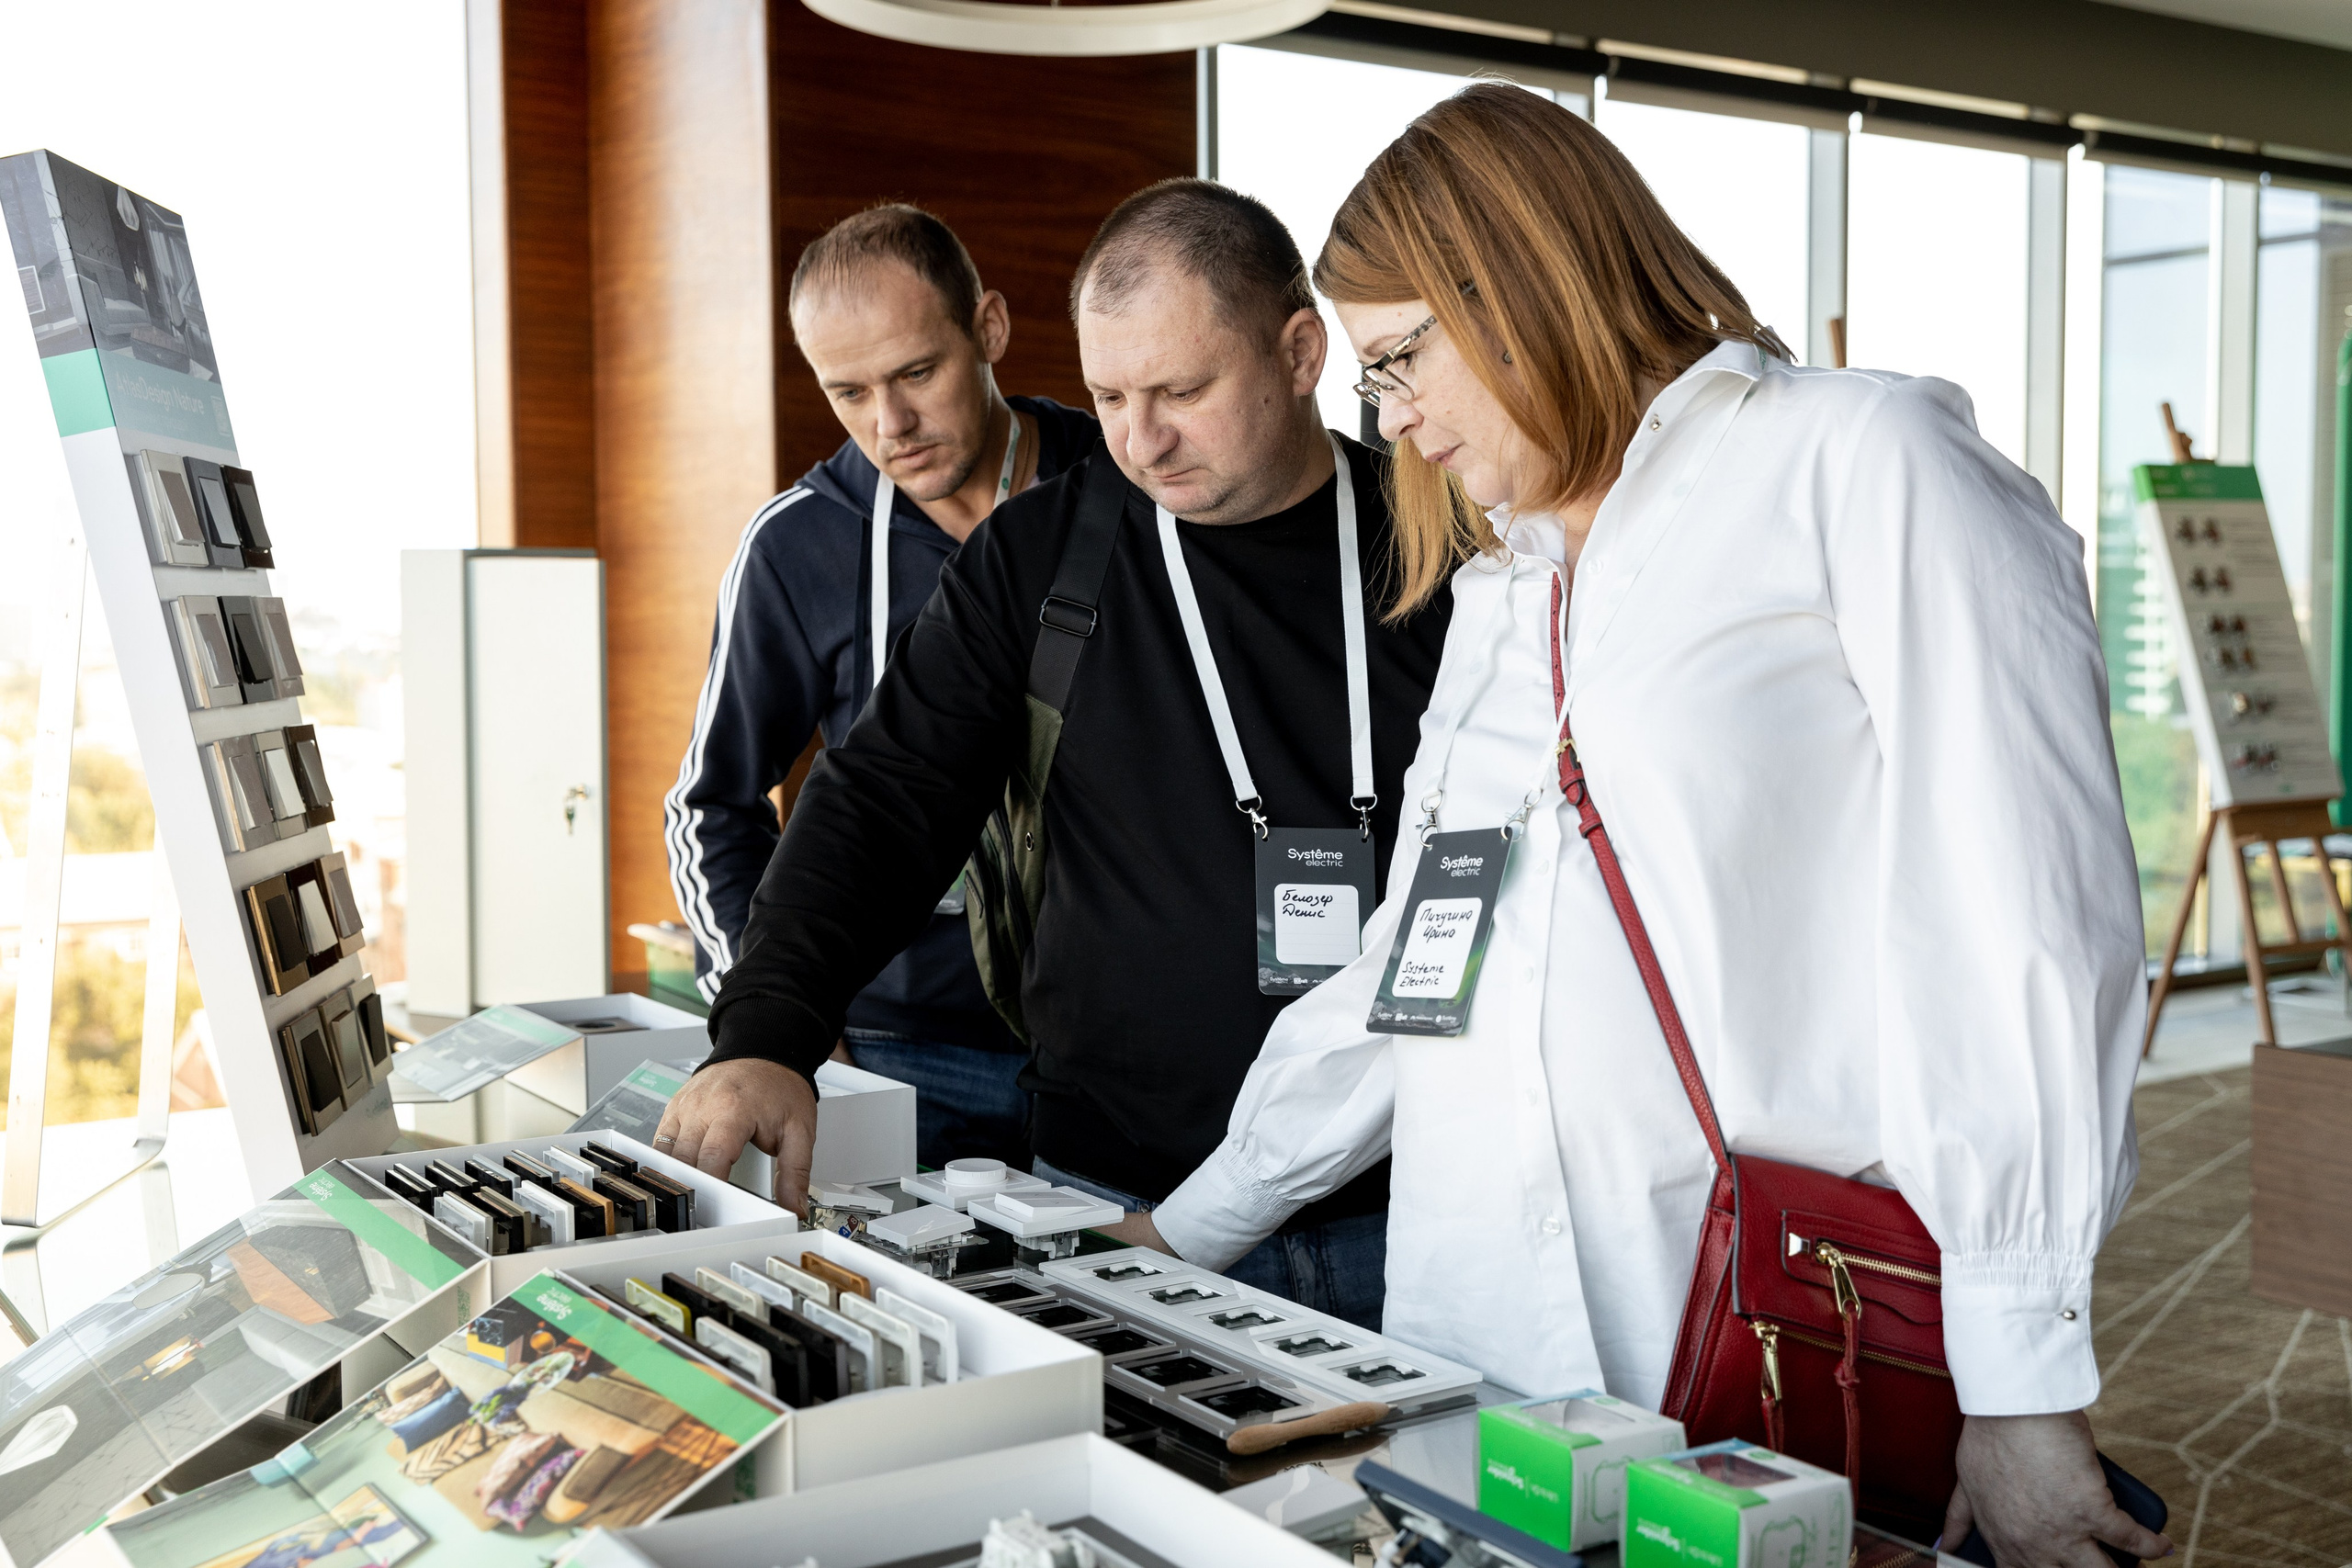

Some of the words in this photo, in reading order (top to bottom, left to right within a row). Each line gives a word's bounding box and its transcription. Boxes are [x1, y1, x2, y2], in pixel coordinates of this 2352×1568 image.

[116, 372, 174, 412] AtlasDesign
[172, 387, 205, 415] Nature
[1287, 848, 1343, 861] Systême
[1306, 858, 1343, 867] electric
[1440, 854, 1483, 871] Systême
[1451, 867, 1481, 877] electric
[1282, 888, 1333, 908] Белозер
[1282, 903, 1326, 919] Денис
[1419, 908, 1473, 928] Пичугина
[1423, 925, 1456, 943] Ирина
[1402, 961, 1444, 975] Systeme
[1399, 976, 1440, 987] Electric
